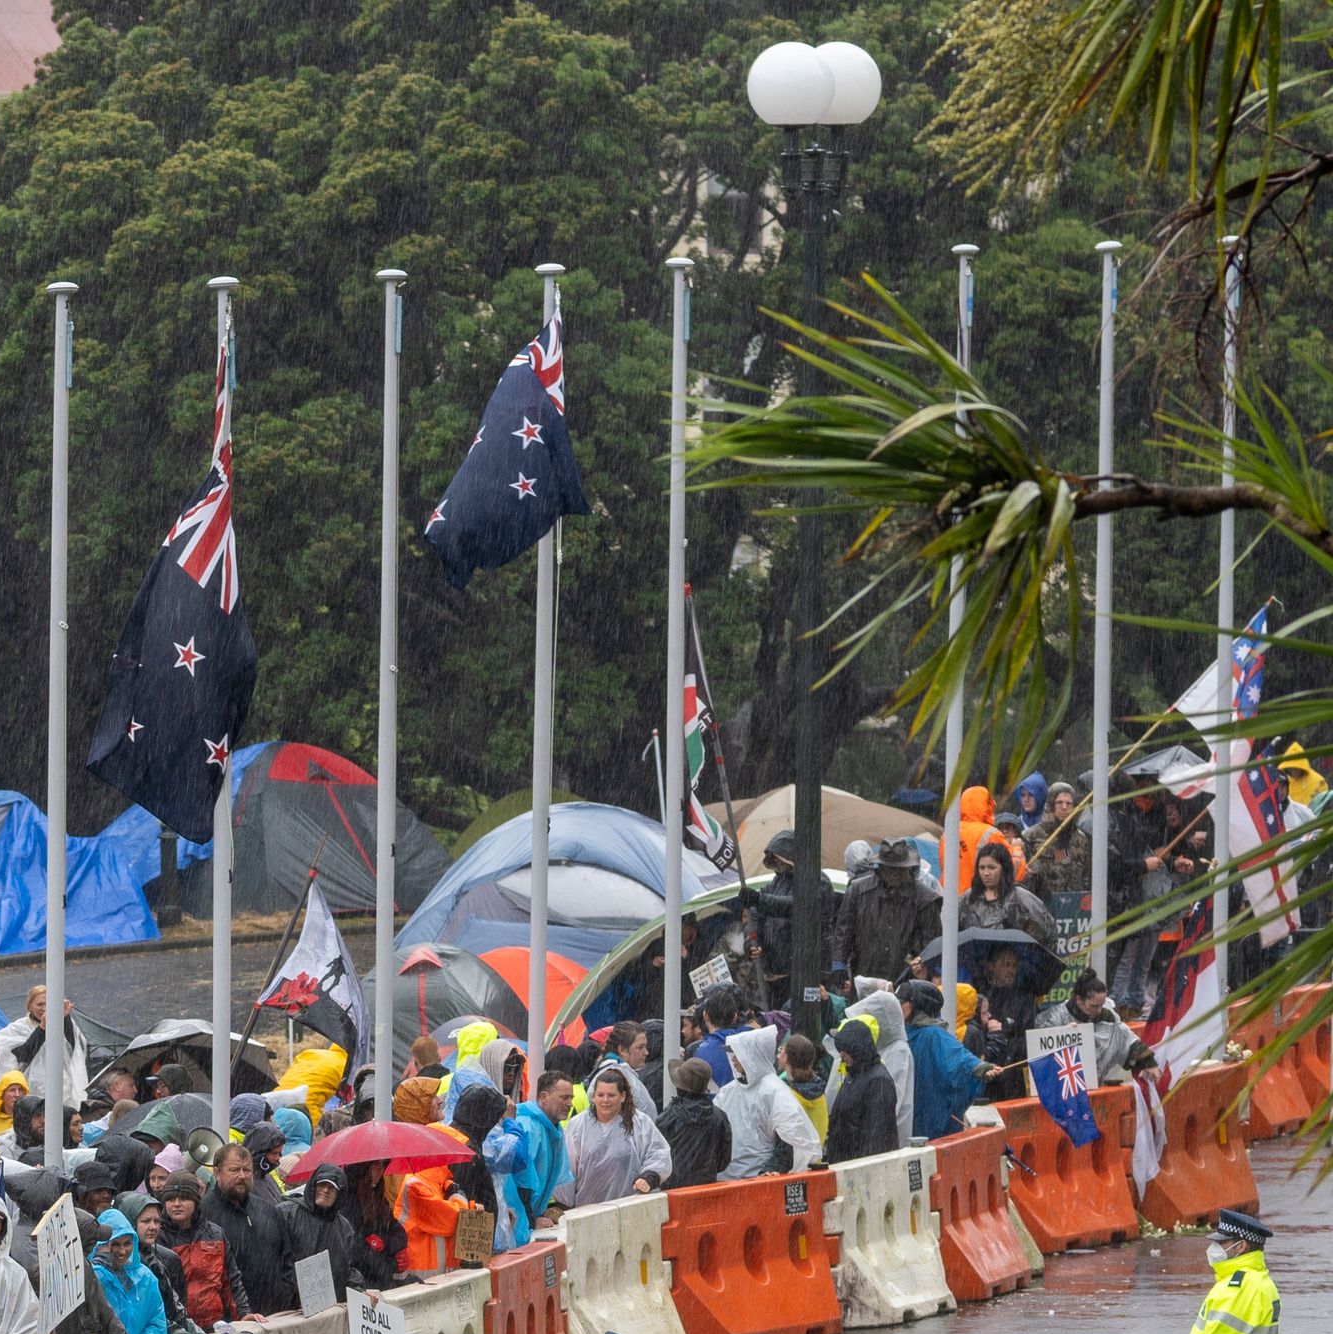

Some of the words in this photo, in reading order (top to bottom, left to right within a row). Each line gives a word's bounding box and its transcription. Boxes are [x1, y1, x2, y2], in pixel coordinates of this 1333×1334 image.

[1040, 1036, 1054, 1050] NO
[1056, 1033, 1083, 1047] MORE
[361, 1304, 376, 1324] END
[378, 1312, 391, 1330] ALL
